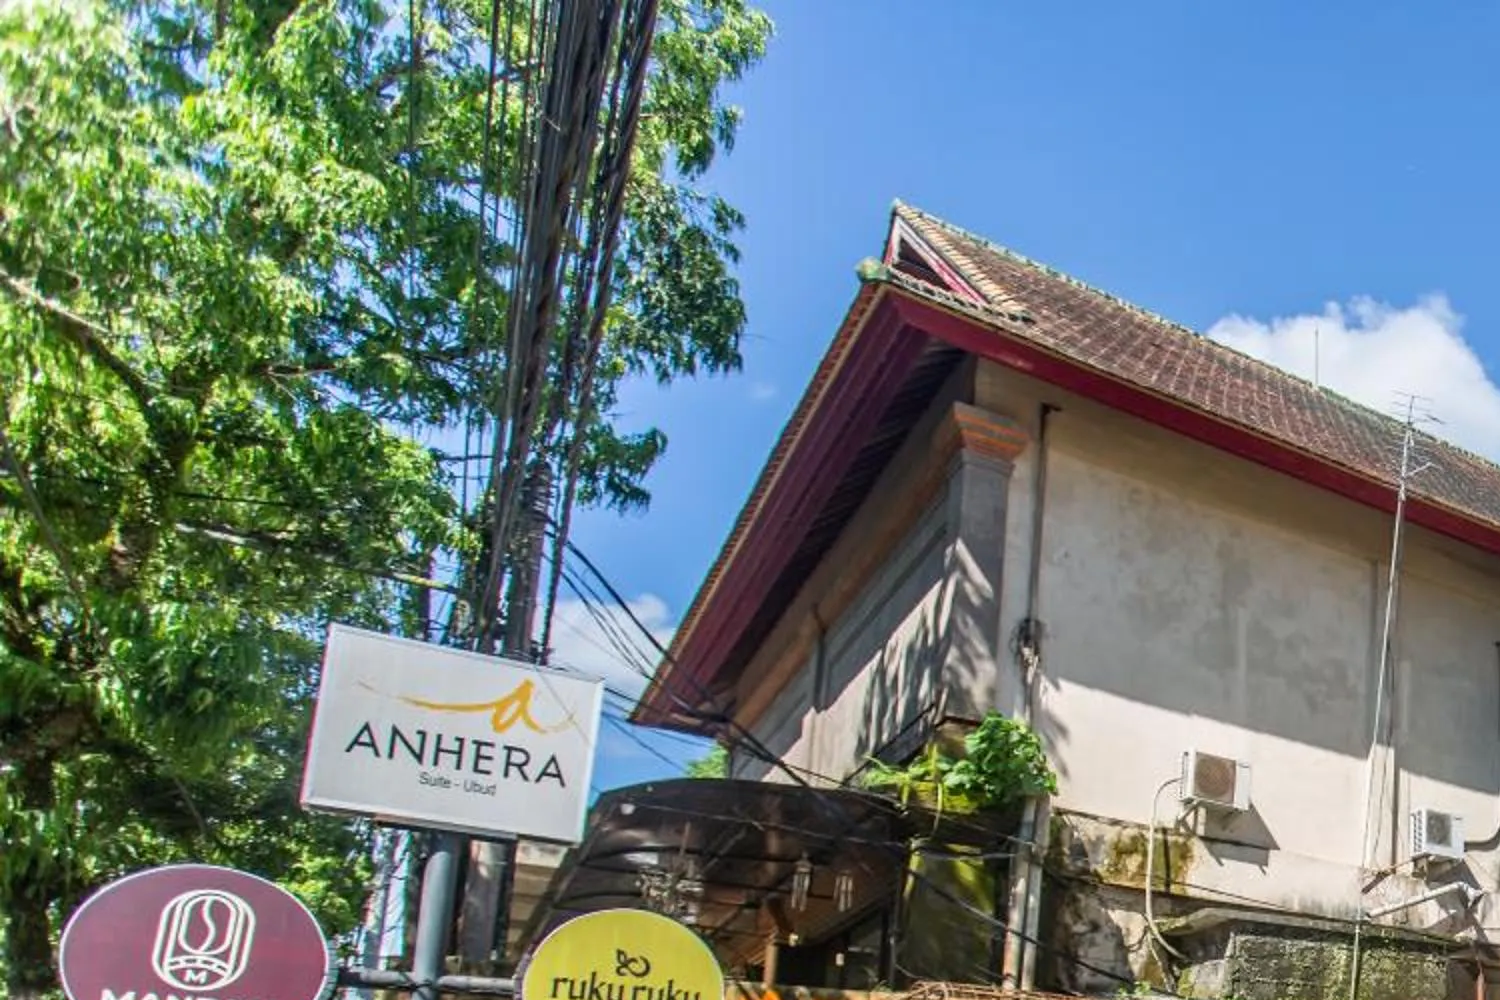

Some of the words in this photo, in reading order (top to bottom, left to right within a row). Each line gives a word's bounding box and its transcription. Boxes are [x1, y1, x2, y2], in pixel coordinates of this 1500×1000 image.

[344, 721, 566, 788] ANHERA
[418, 771, 451, 789] Suite
[463, 779, 498, 797] Ubud
[184, 970, 206, 984] M
